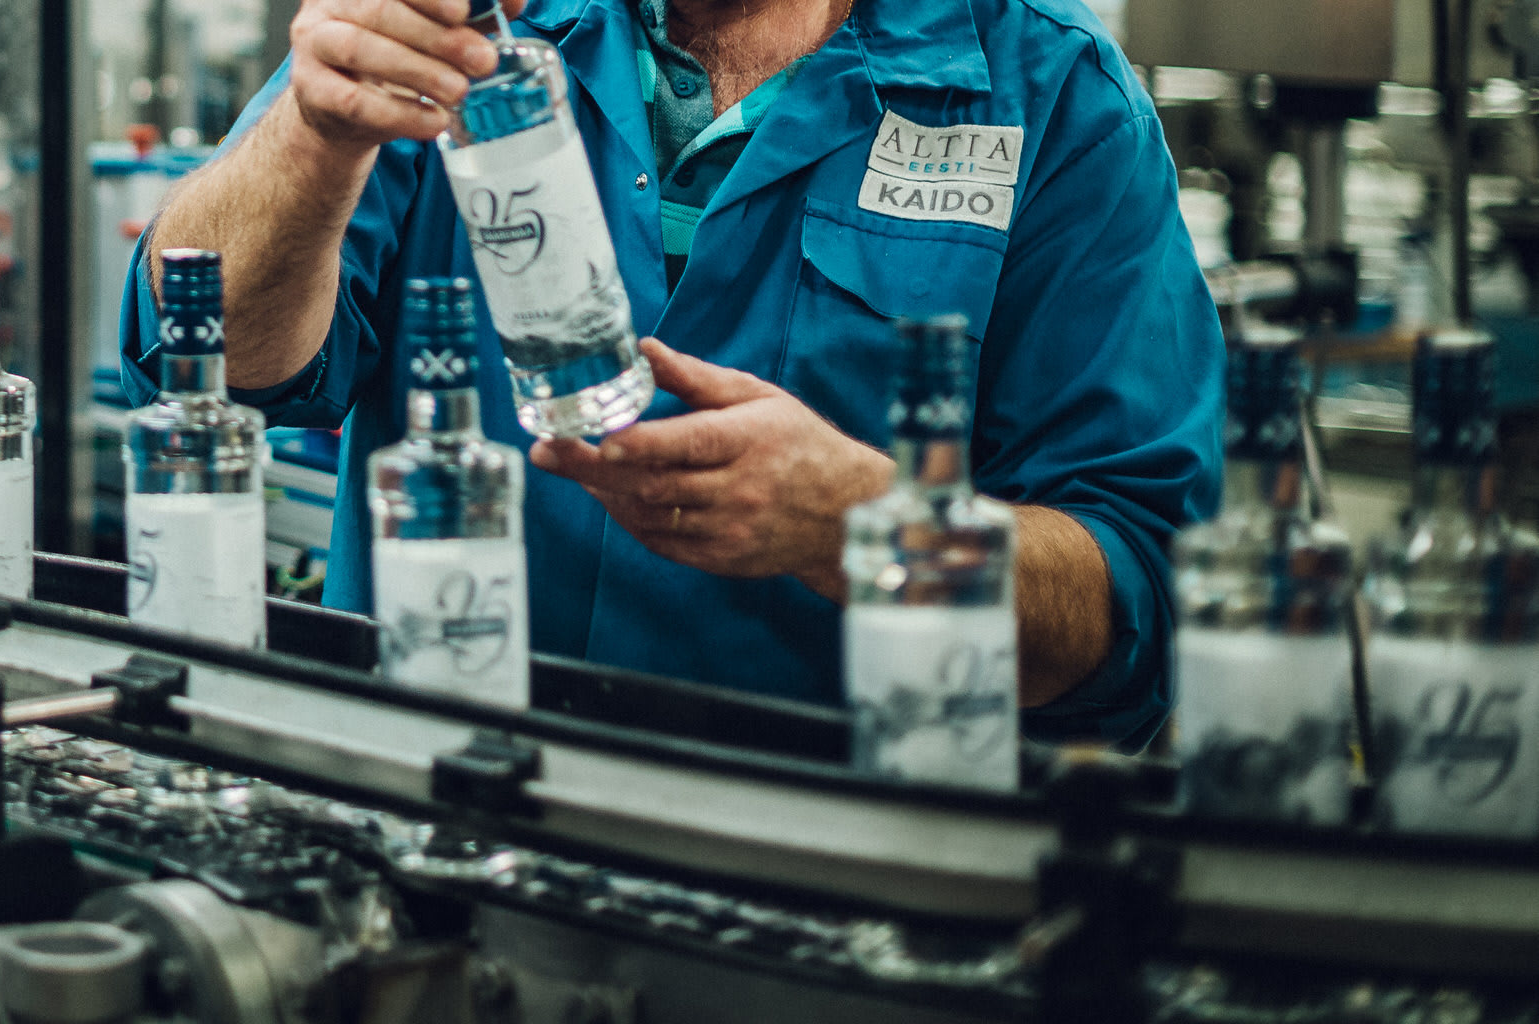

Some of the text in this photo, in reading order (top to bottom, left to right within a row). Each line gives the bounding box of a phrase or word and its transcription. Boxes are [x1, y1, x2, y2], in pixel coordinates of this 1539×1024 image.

[880, 126, 1012, 162] ALTIA
[908, 161, 975, 174] EESTI
[877, 182, 996, 216] KAIDO
